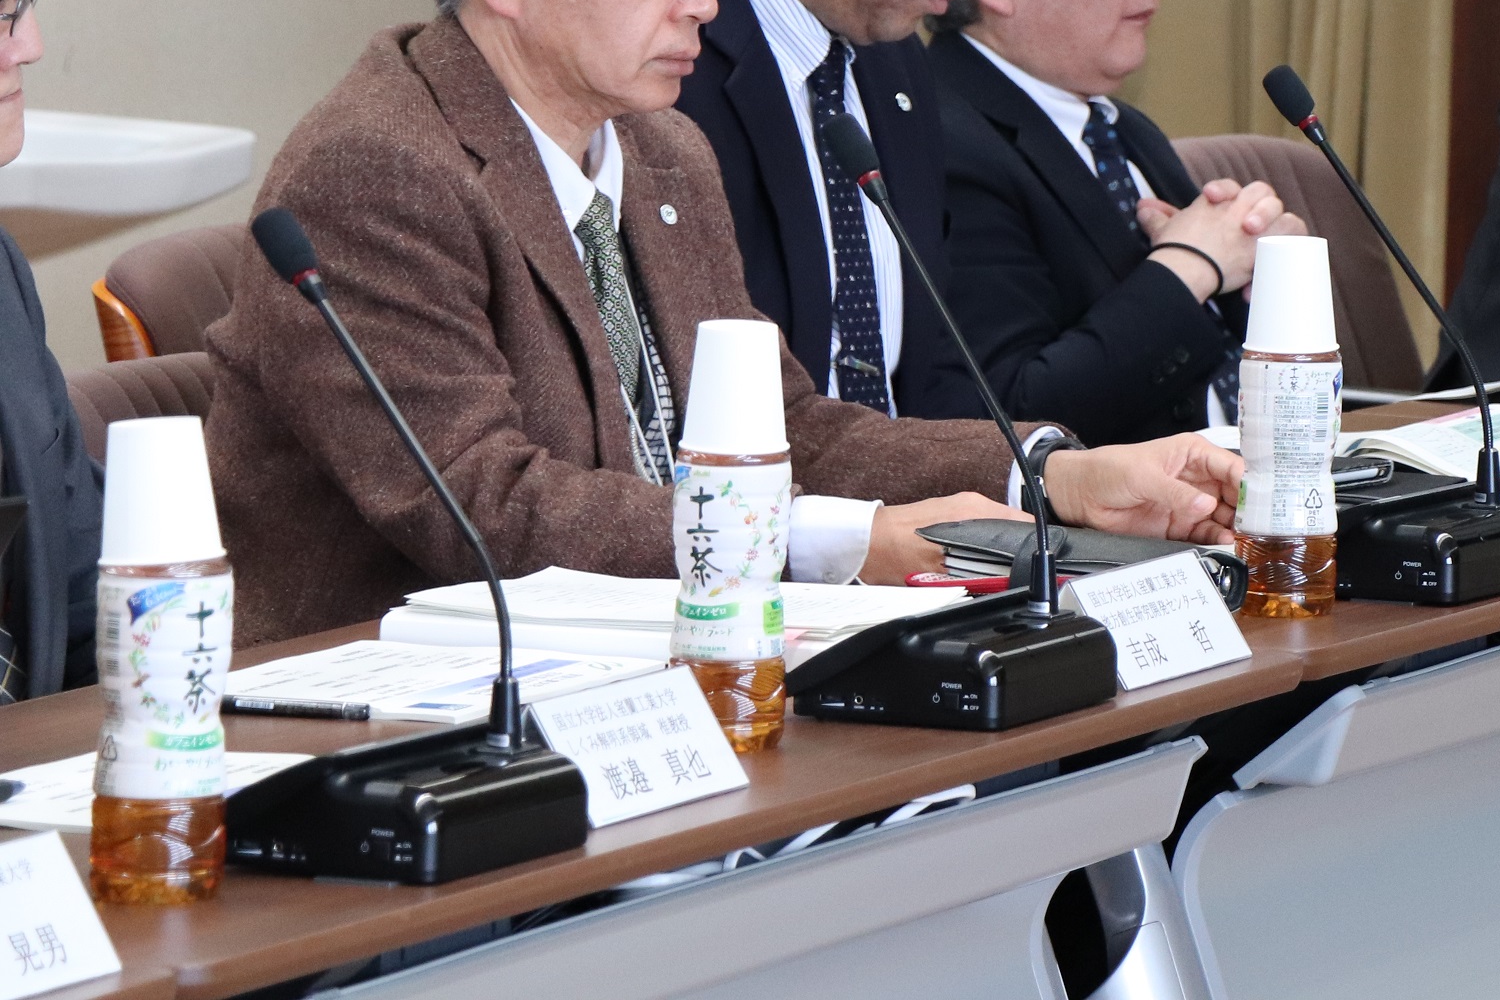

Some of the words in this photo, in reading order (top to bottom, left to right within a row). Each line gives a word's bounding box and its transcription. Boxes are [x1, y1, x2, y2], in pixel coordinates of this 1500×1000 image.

[687, 486, 723, 587] 十六茶
[182, 601, 218, 715] 十六茶
[1126, 632, 1168, 670] 吉成
[1189, 620, 1214, 653] 哲
[661, 744, 712, 786] 真也
[370, 828, 395, 837] POWER
[8, 922, 68, 976] 晃男
